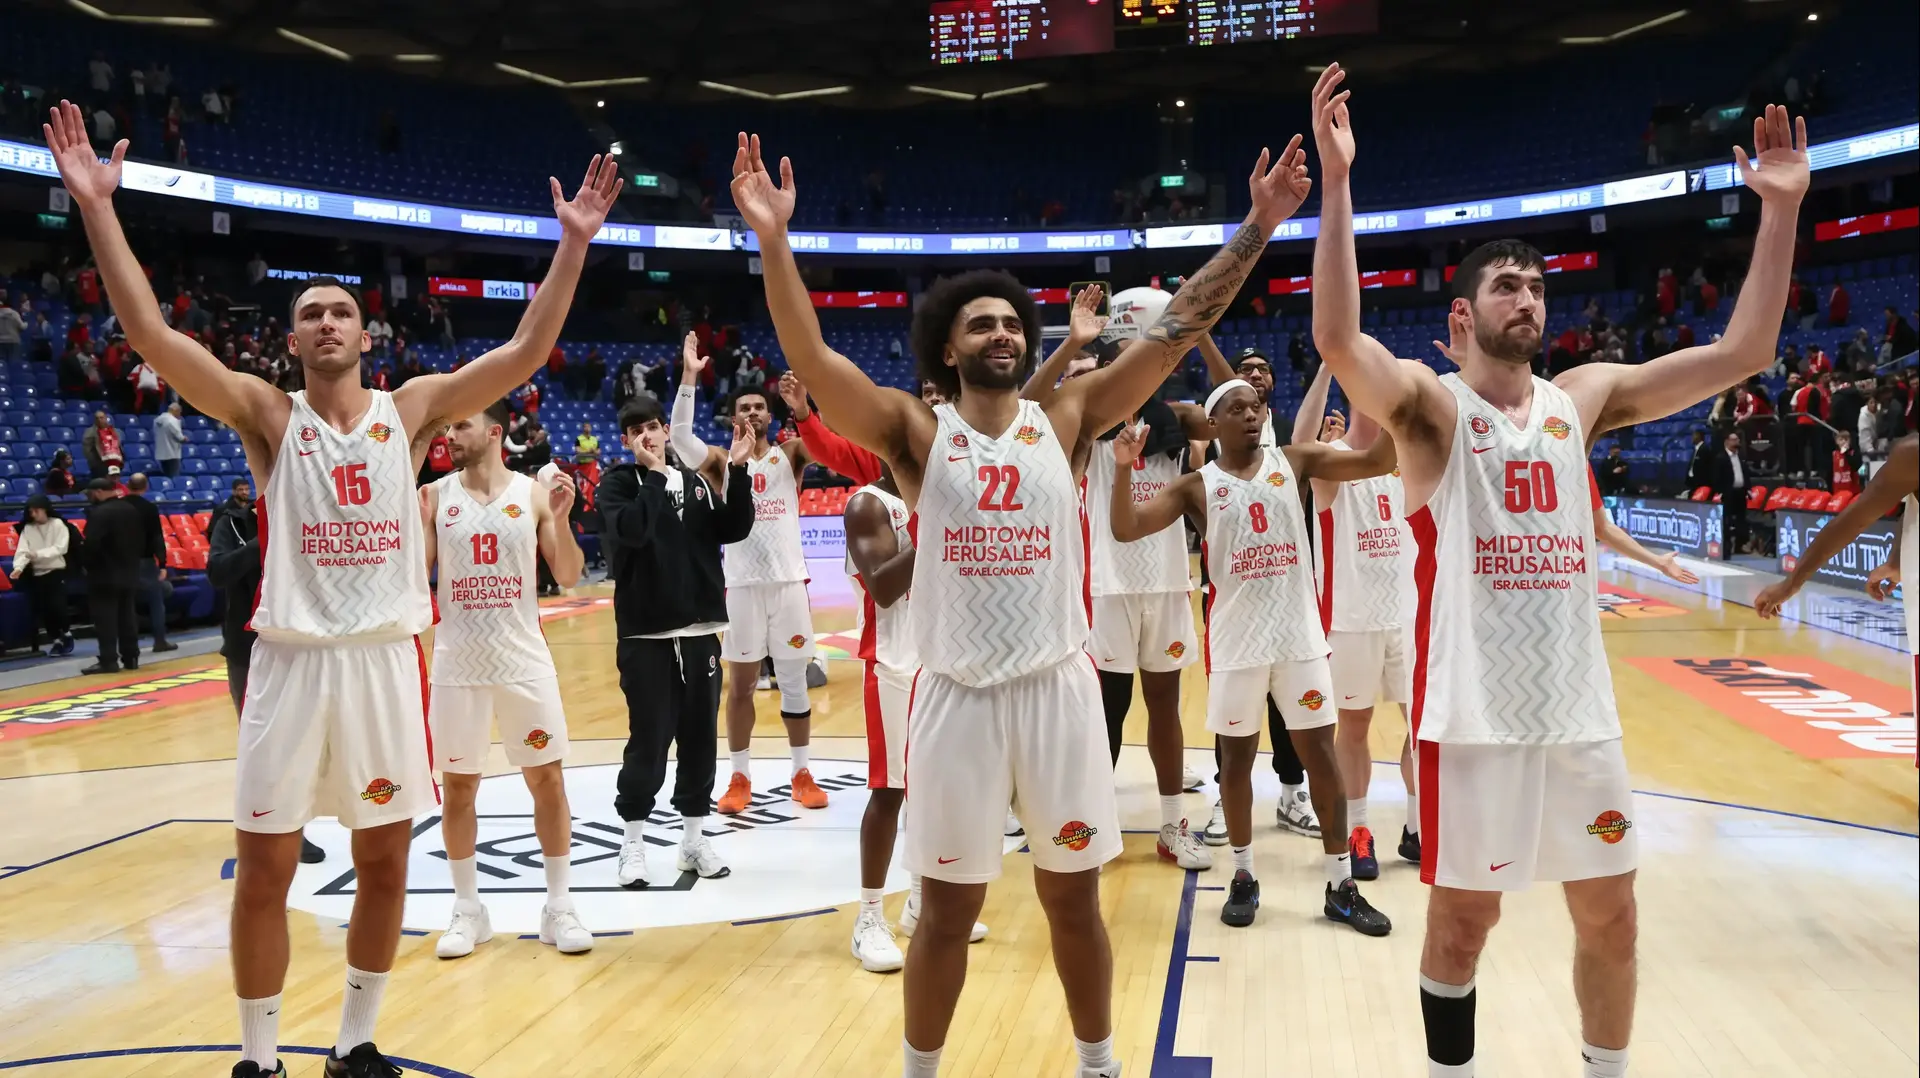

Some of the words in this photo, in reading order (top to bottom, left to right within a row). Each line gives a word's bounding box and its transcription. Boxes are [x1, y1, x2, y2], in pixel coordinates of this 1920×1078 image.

[487, 283, 520, 298] arkia
[331, 463, 372, 506] 15
[754, 473, 766, 494] 0
[978, 465, 1023, 511] 22
[1504, 461, 1558, 513] 50
[756, 507, 786, 515] SALEM
[1377, 494, 1391, 521] 6
[1249, 502, 1269, 534] 8
[302, 519, 400, 537] MIDTOWN
[821, 530, 846, 538] וכנות
[944, 526, 1050, 543] MIDTOWN
[1358, 527, 1400, 540] MIDTO
[301, 536, 401, 554] JERUSALEM
[470, 533, 499, 565] 13
[942, 544, 1051, 562] JERUSALEM
[1231, 543, 1297, 562] MIDTOWN
[1358, 538, 1400, 551] JERUSA
[1476, 535, 1584, 554] MIDTOWN
[1230, 556, 1298, 575] JERUSALEM
[1473, 556, 1586, 574] JERUSALEM
[452, 576, 522, 589] MIDTOWN
[451, 588, 521, 602] JERUSALEM
[360, 788, 393, 801] Winner
[1052, 830, 1090, 846] Winner
[1586, 823, 1626, 835] Winner
